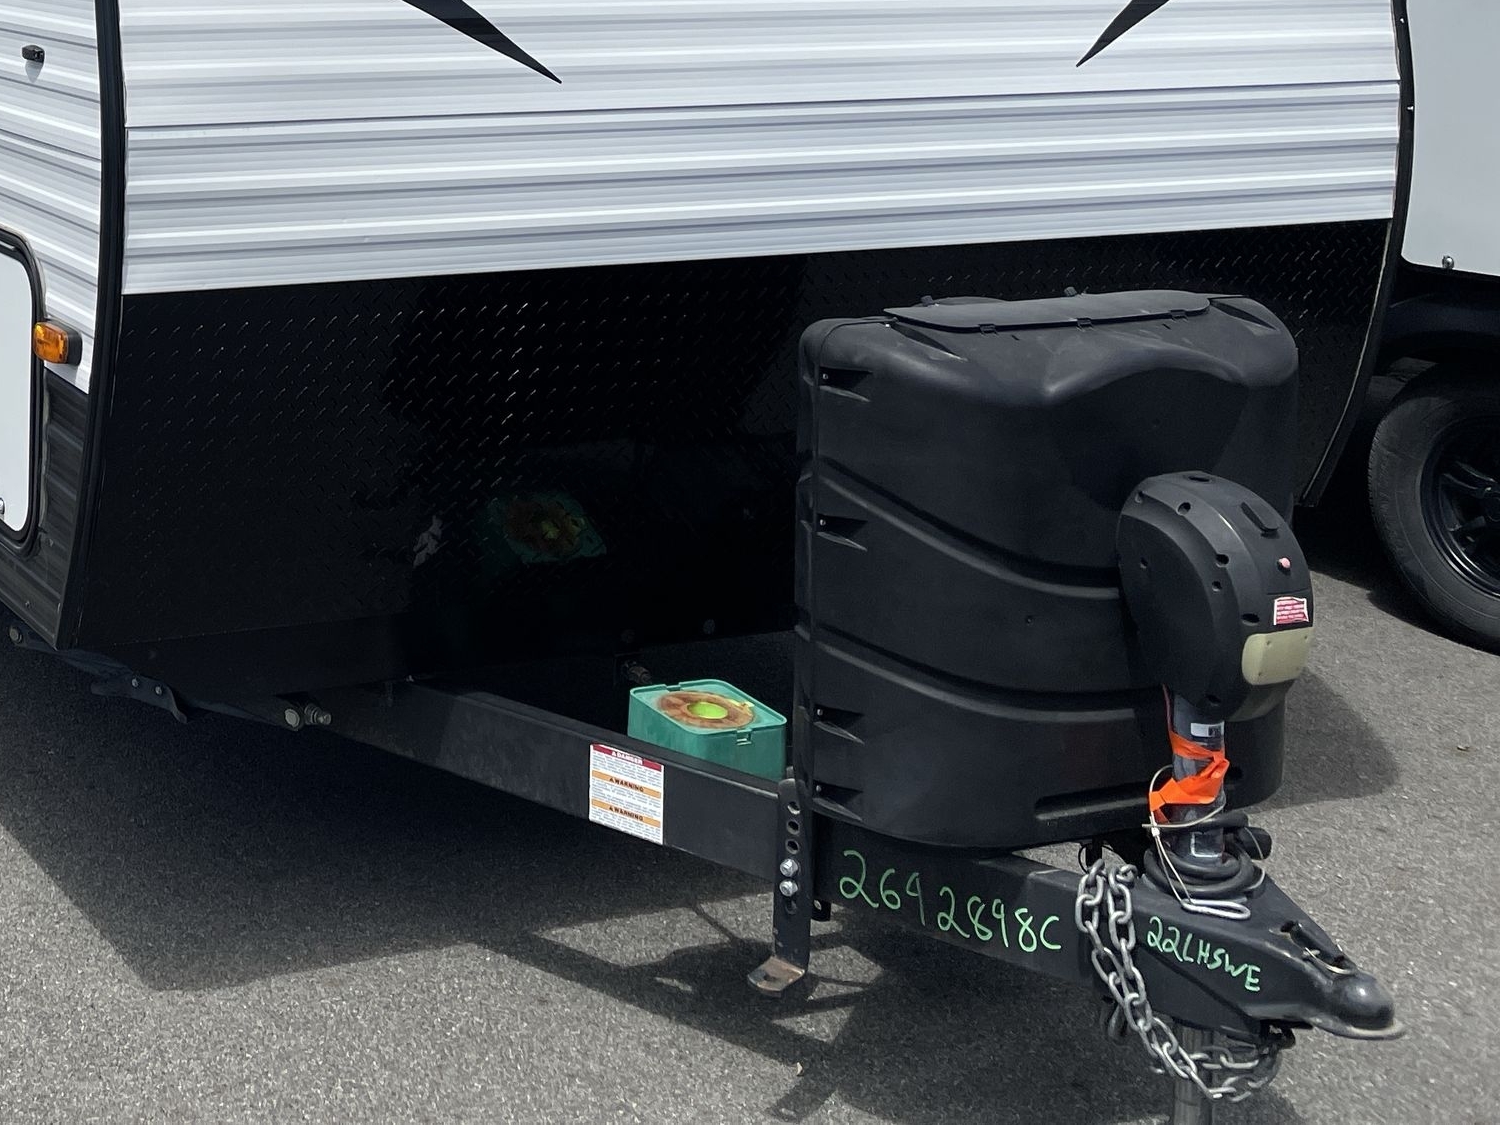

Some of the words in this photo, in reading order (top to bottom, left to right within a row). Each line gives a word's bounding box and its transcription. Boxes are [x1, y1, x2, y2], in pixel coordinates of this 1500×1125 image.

[616, 752, 643, 764] DANGER
[615, 778, 643, 792] WARNING
[614, 807, 644, 821] WARNING
[1146, 915, 1261, 992] 22LHSWE
